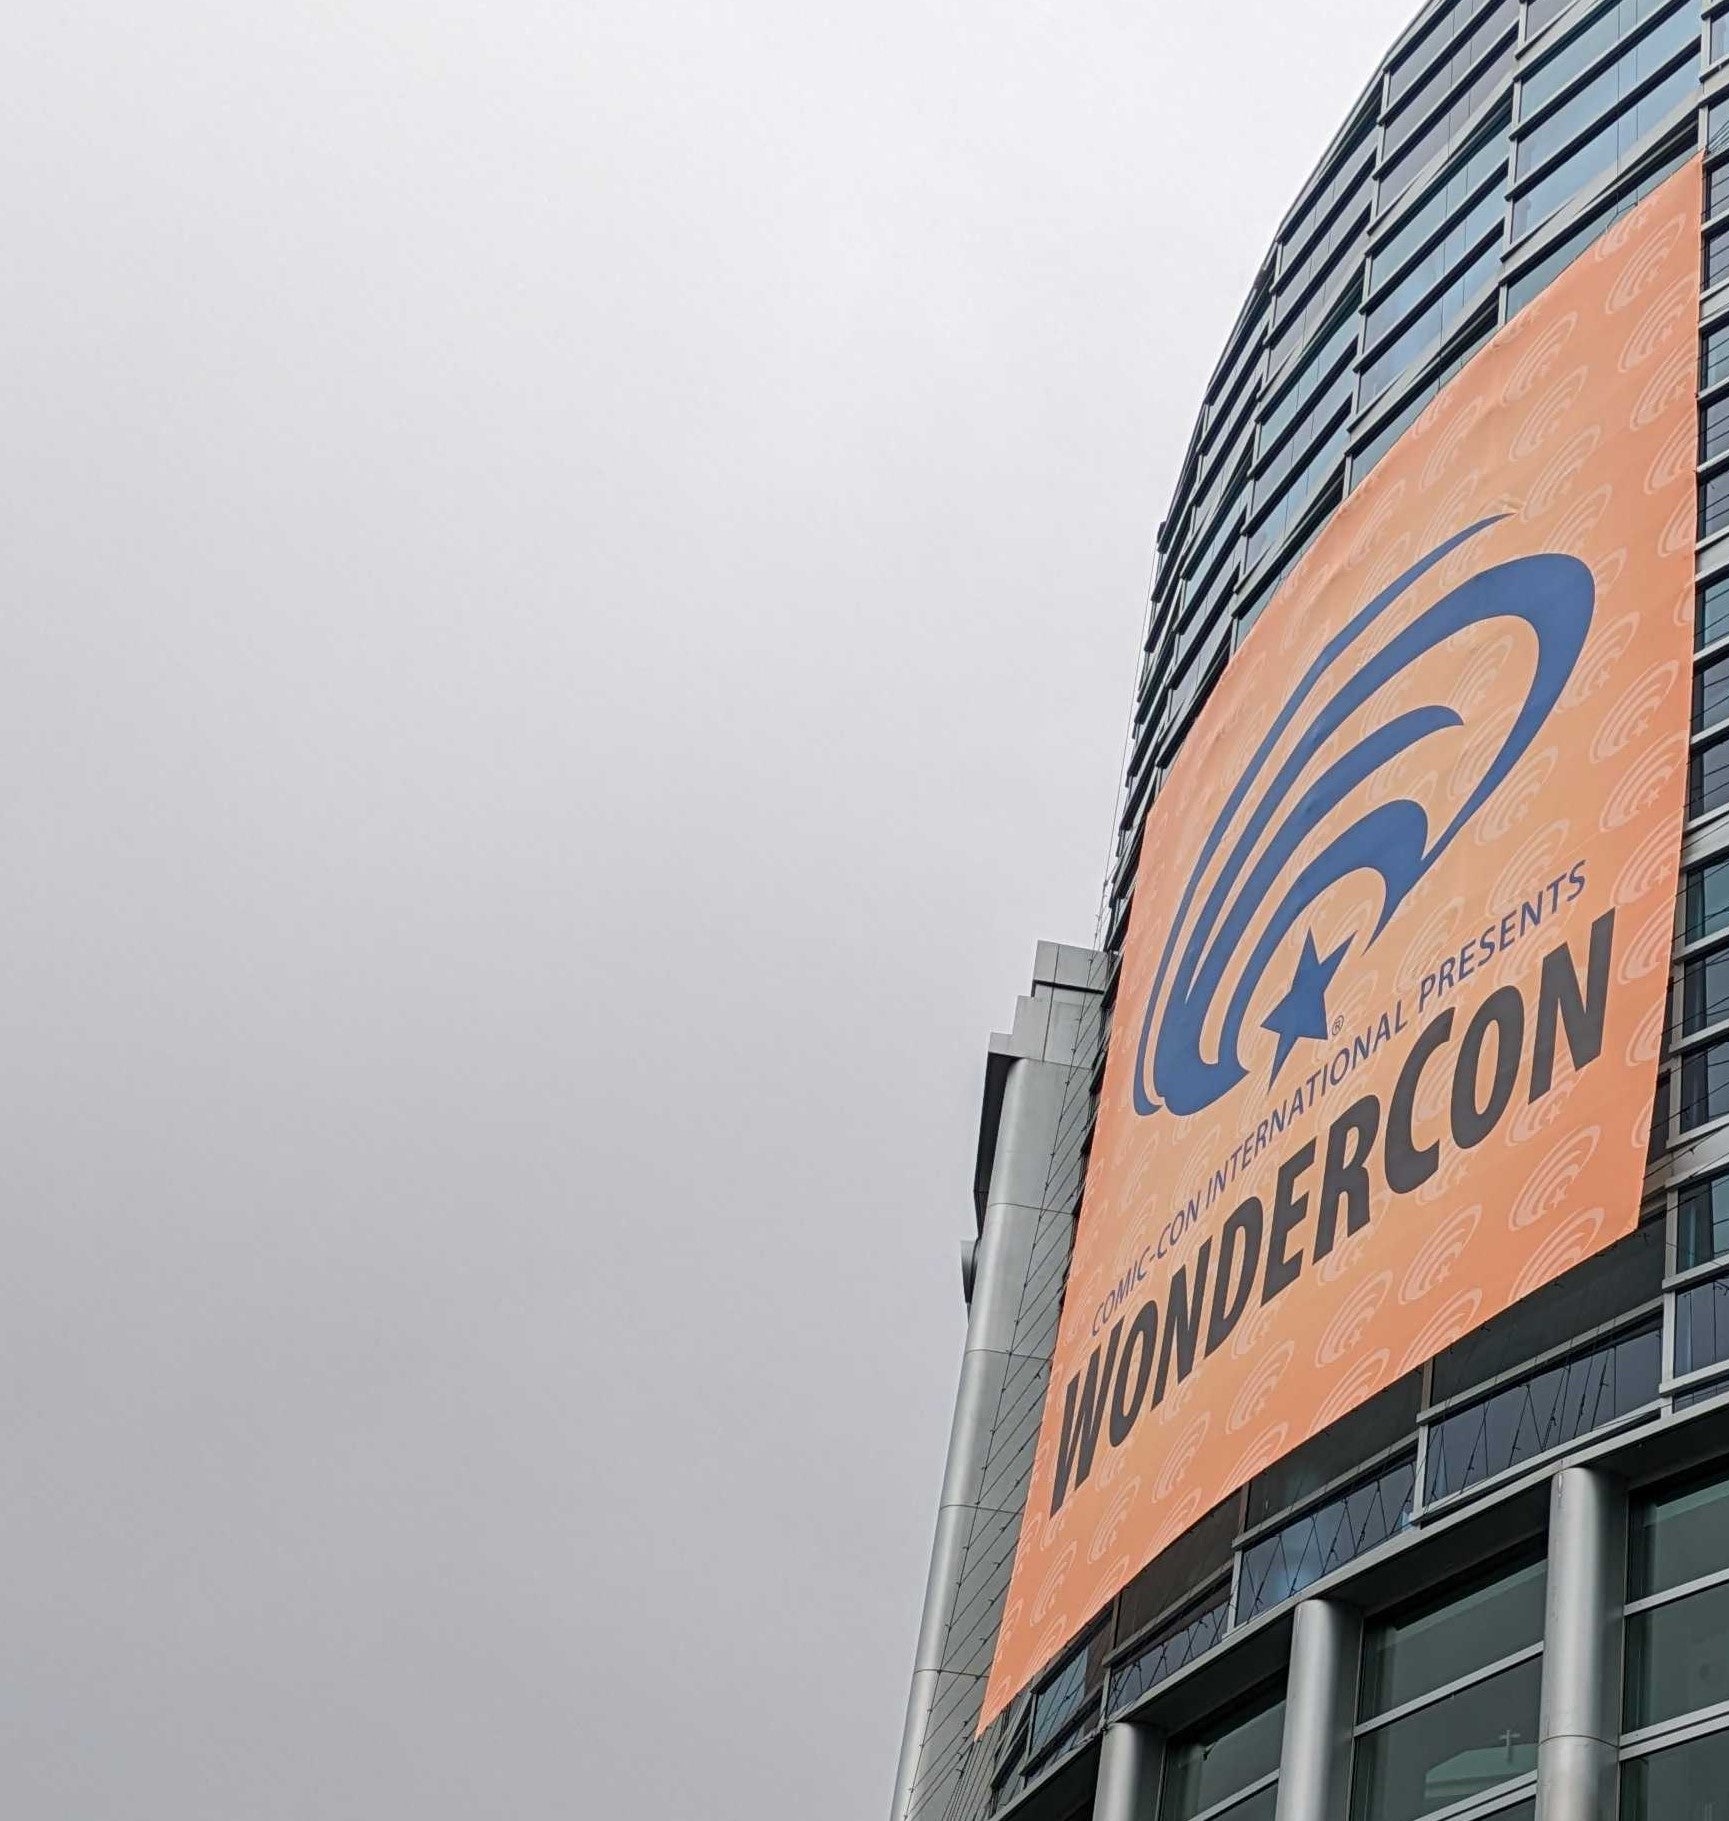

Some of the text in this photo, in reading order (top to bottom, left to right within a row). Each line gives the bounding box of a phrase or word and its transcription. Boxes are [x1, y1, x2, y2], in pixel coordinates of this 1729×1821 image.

[1050, 906, 1616, 1519] WONDERCON
[1092, 859, 1586, 1336] COMIC-CON INTERNATIONAL PRESENTS
